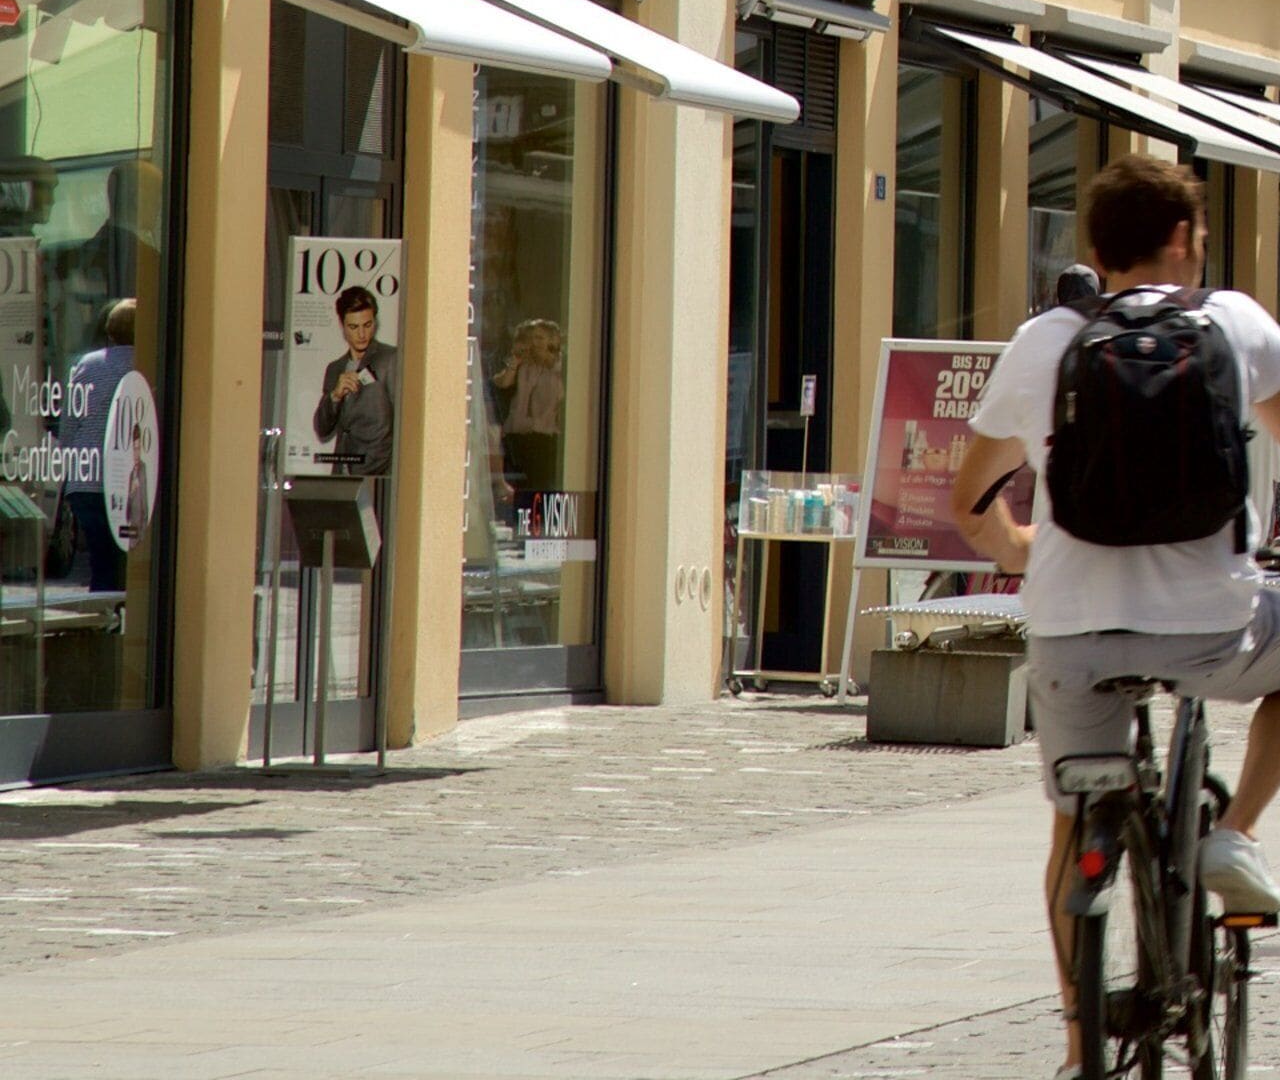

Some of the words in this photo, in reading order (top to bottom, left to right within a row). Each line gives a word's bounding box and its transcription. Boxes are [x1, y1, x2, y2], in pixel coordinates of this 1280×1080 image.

[297, 248, 399, 297] 10%
[952, 355, 973, 369] BIS
[975, 356, 991, 370] ZU
[11, 365, 62, 417] Made
[66, 366, 94, 417] for
[113, 394, 151, 452] 10%
[2, 429, 100, 483] Gentlemen
[518, 508, 531, 536] THE
[532, 492, 541, 537] G
[543, 493, 578, 537] VISION
[894, 538, 924, 549] VISION
